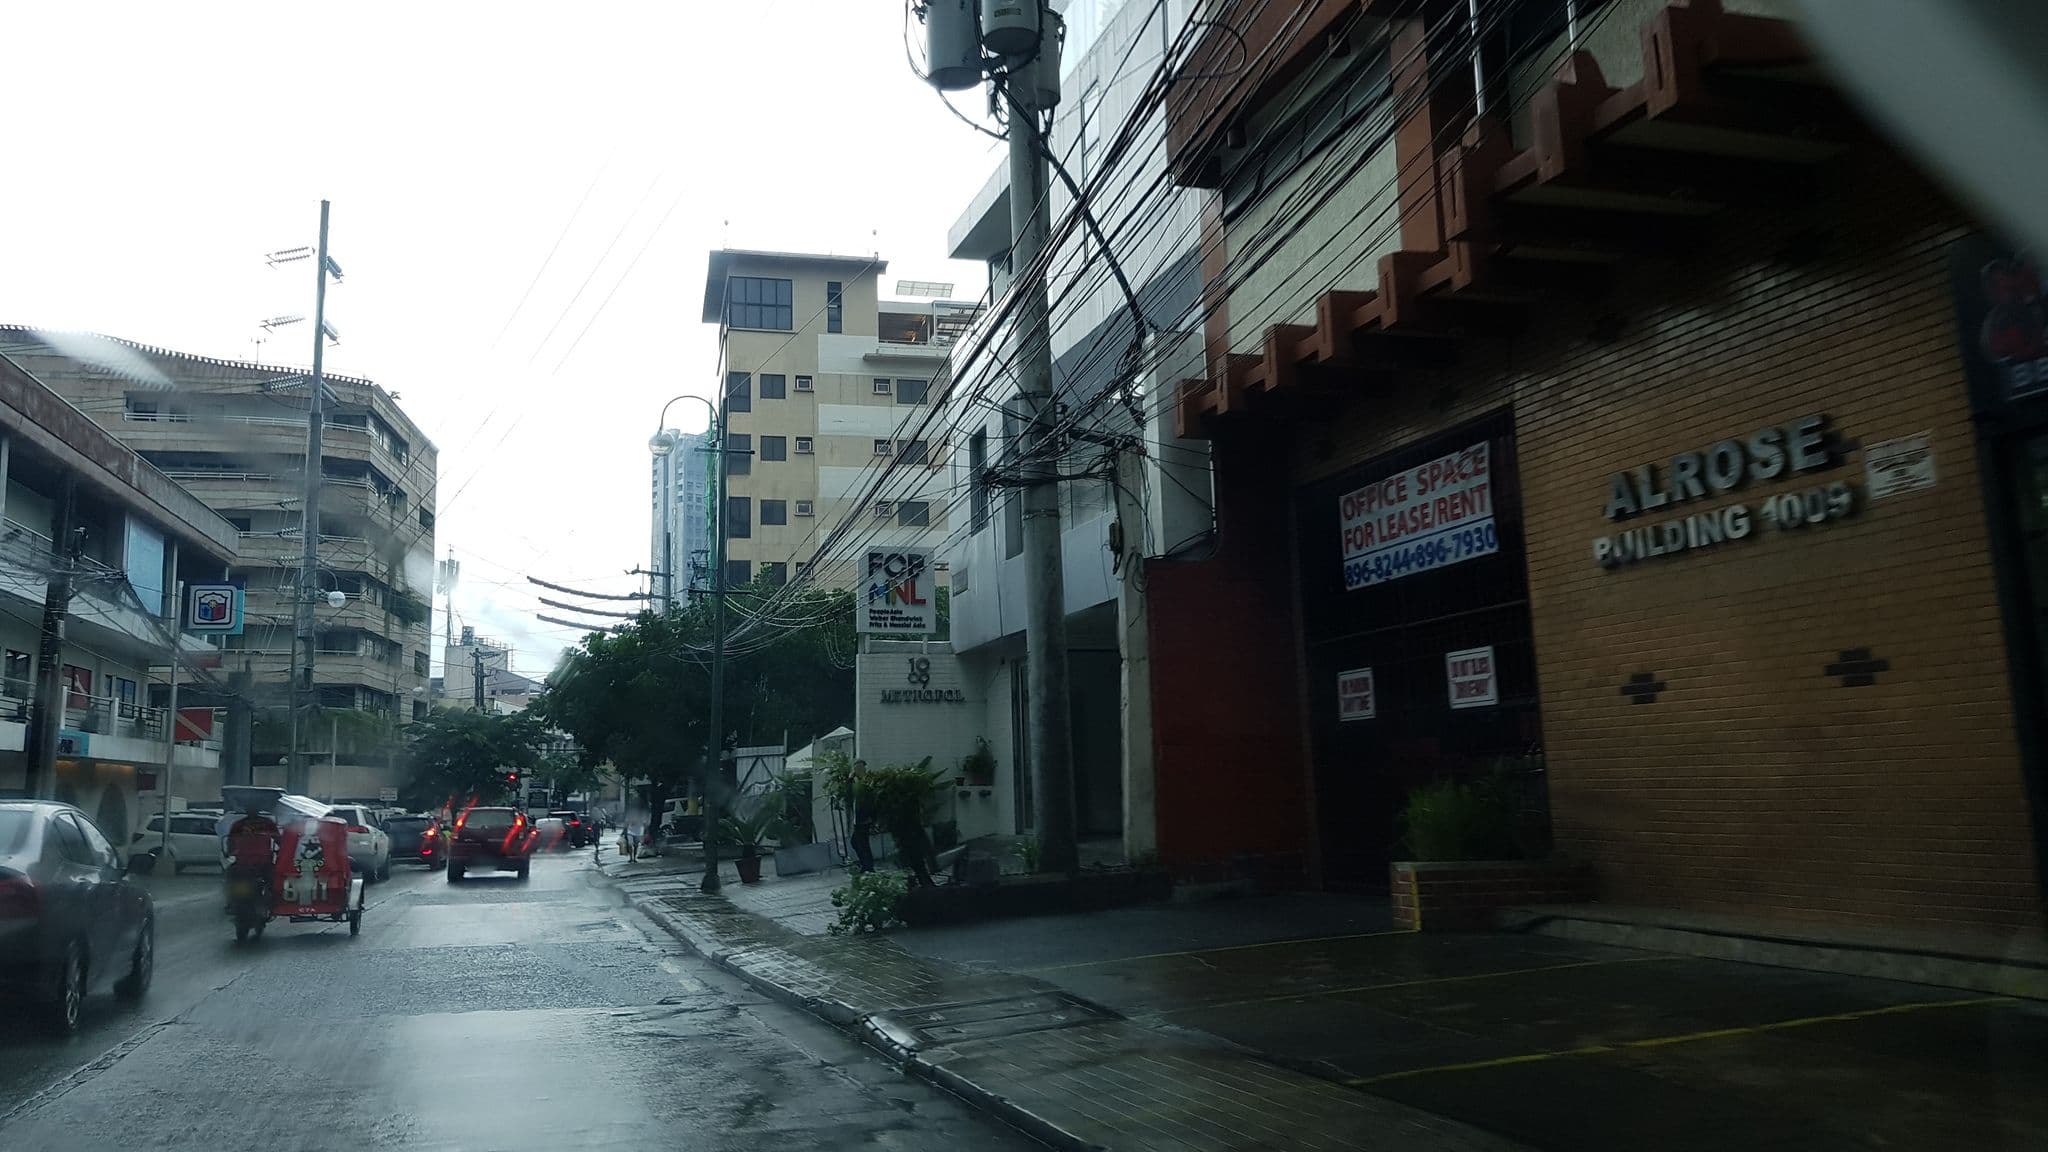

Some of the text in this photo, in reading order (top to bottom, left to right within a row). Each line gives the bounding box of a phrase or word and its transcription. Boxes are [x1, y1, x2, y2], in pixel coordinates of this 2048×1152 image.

[1343, 446, 1487, 521] OFFICE SPACE
[1606, 413, 1832, 520] ALROSE
[1344, 483, 1488, 554] FOR LEASE/RENT
[1593, 501, 1753, 568] BUILDING
[868, 577, 927, 606] MNL
